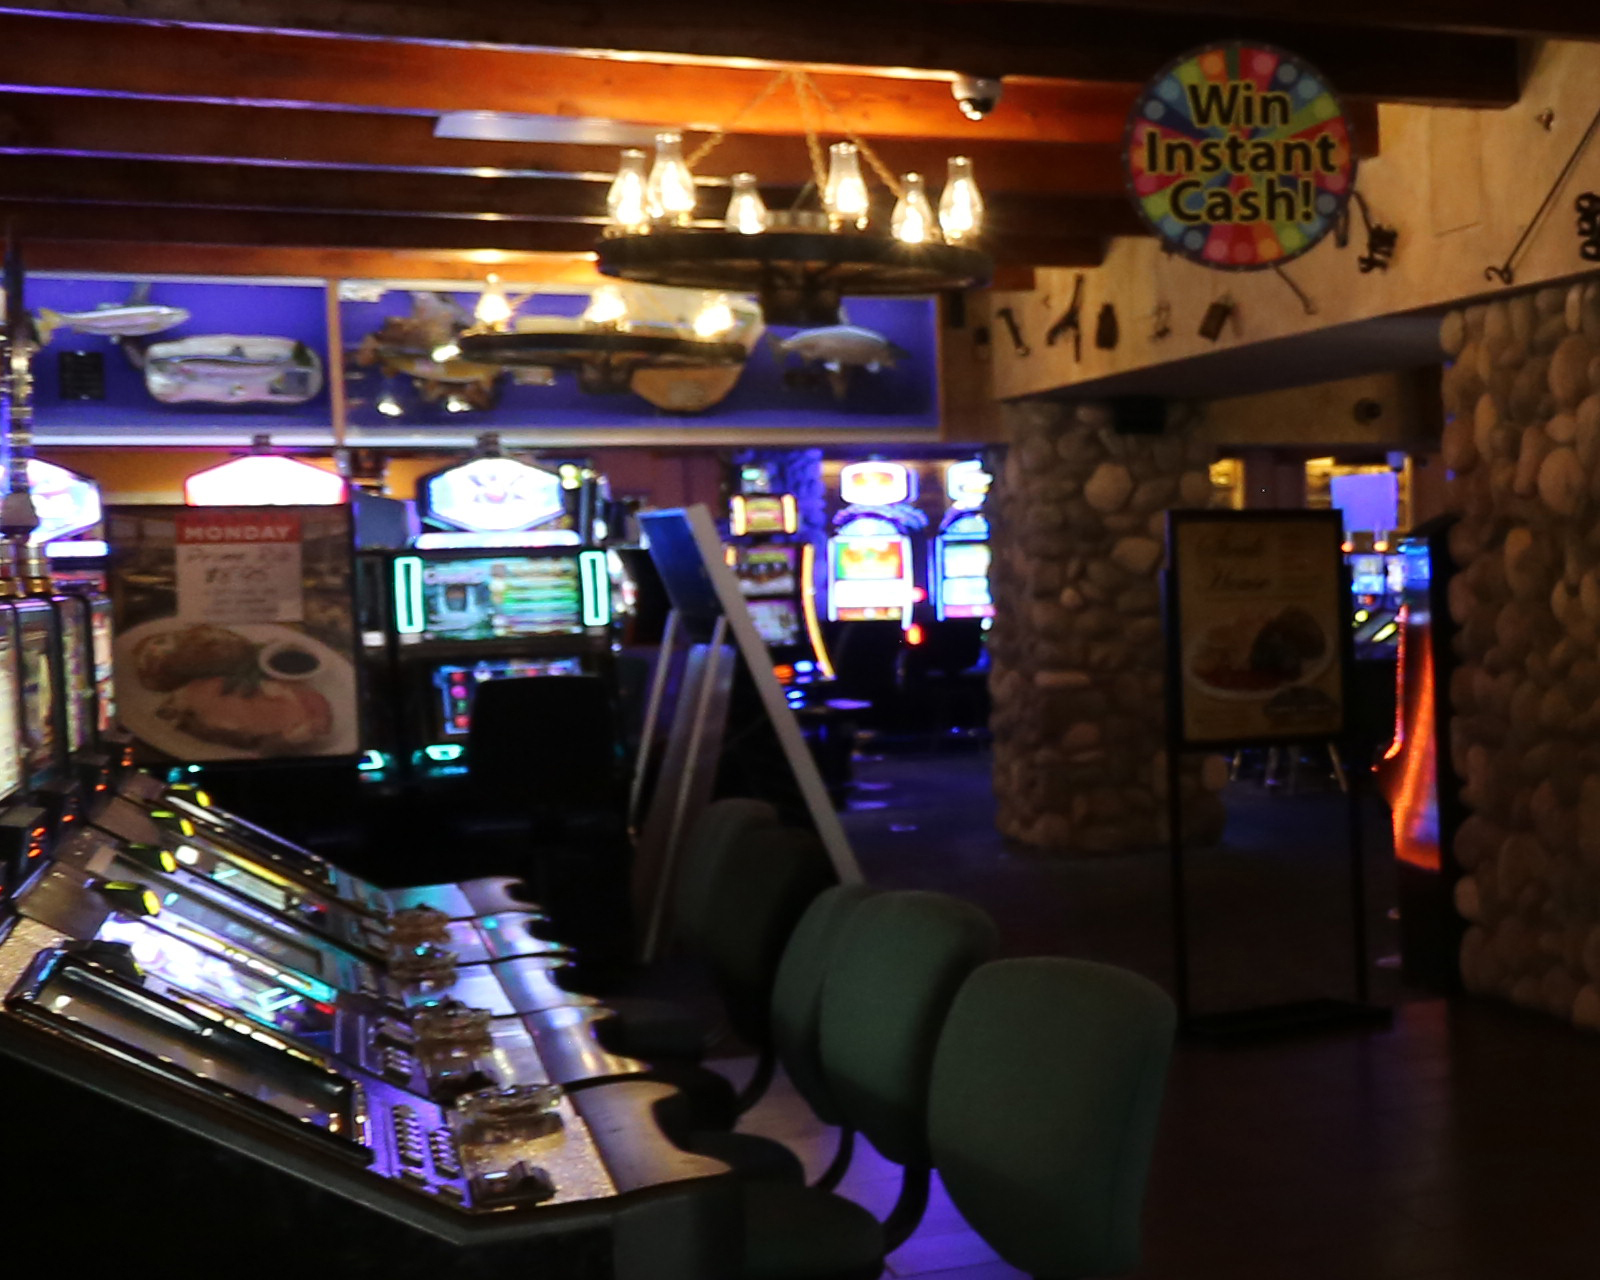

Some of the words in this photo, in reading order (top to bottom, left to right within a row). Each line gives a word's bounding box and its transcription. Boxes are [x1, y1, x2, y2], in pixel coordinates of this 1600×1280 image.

[1188, 82, 1290, 126] Win
[1145, 130, 1337, 174] Instant
[1169, 178, 1313, 222] Cash!
[184, 525, 292, 541] MONDAY
